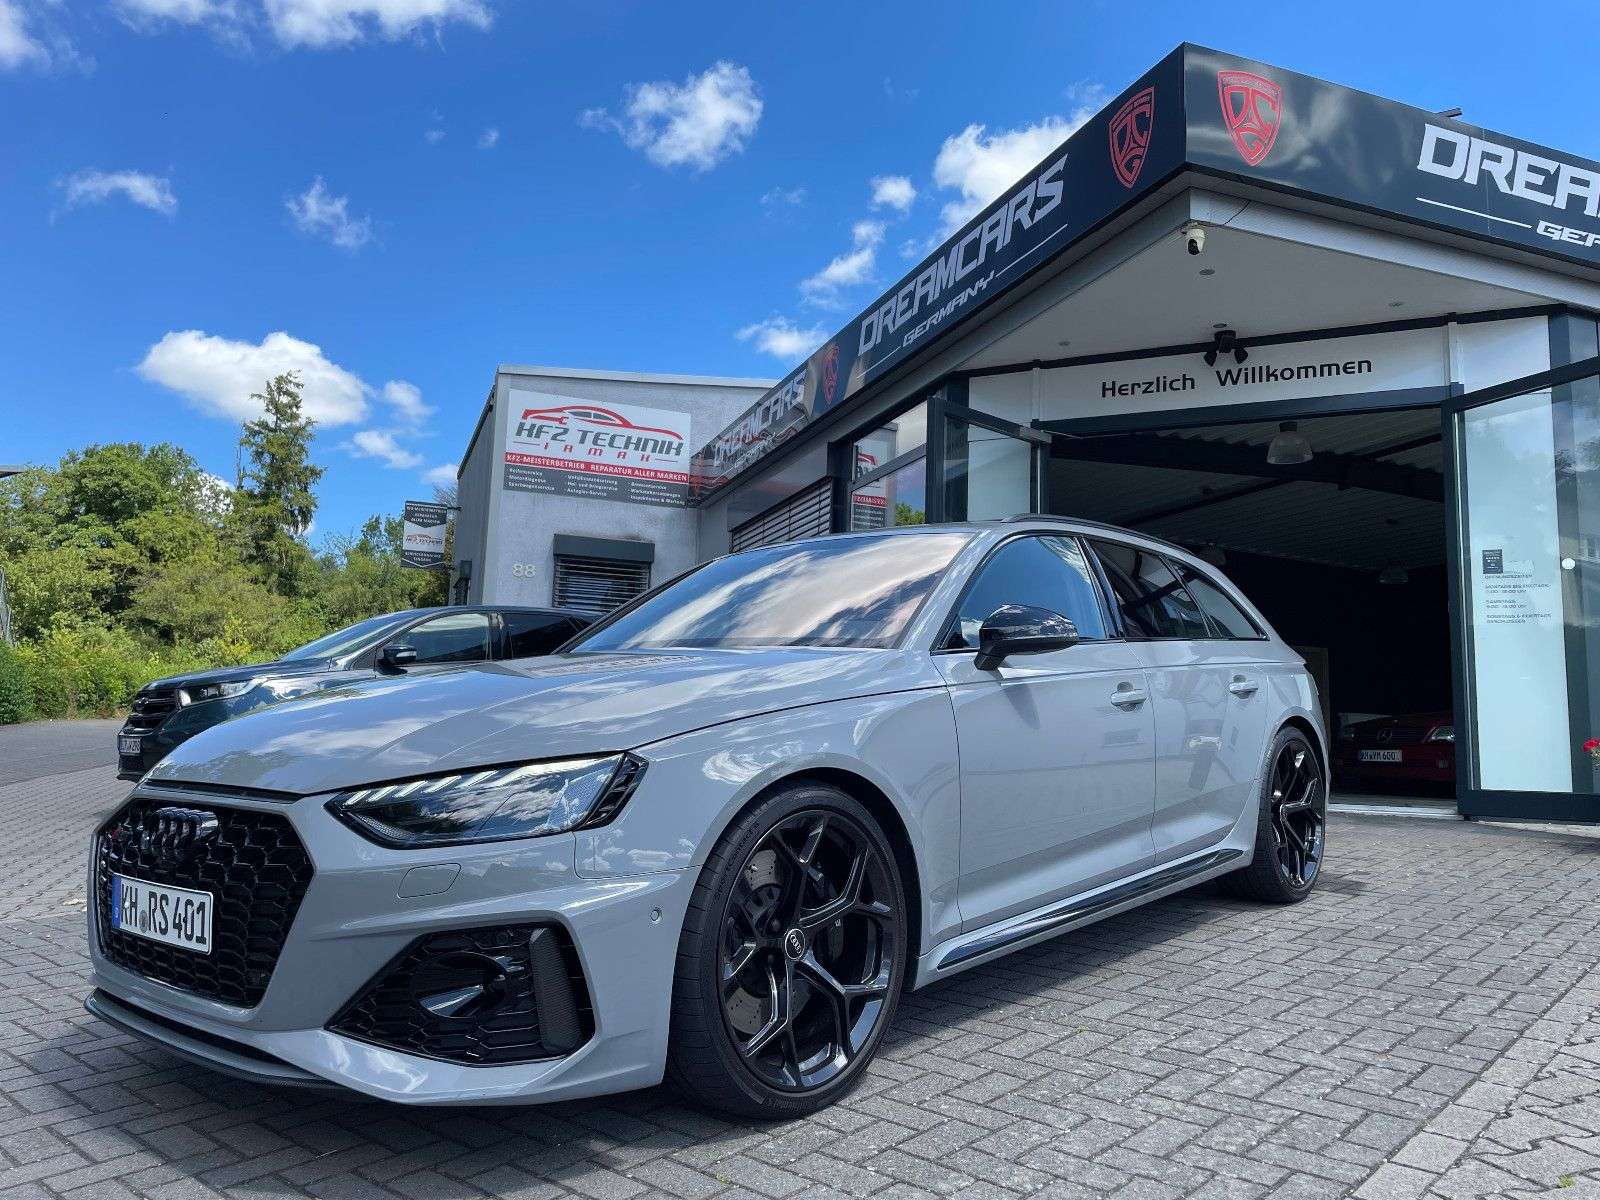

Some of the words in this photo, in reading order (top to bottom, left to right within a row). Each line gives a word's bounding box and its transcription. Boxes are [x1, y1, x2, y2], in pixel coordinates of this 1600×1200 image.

[1417, 123, 1600, 218] DREA
[858, 153, 1068, 357] DREAMCARS
[902, 269, 995, 348] GERMANY
[1101, 373, 1195, 398] Herzlich
[1215, 359, 1372, 387] Willkommen
[577, 428, 684, 457] TECHNIK
[506, 454, 586, 470] KFZ-MEISTERBETRIEB
[590, 464, 633, 476] REPARATUR
[634, 469, 656, 479] ALLER
[656, 472, 687, 483] MARKEN
[512, 563, 537, 578] 88
[121, 883, 139, 928] KH
[148, 890, 169, 936] RS
[172, 896, 207, 945] 401
